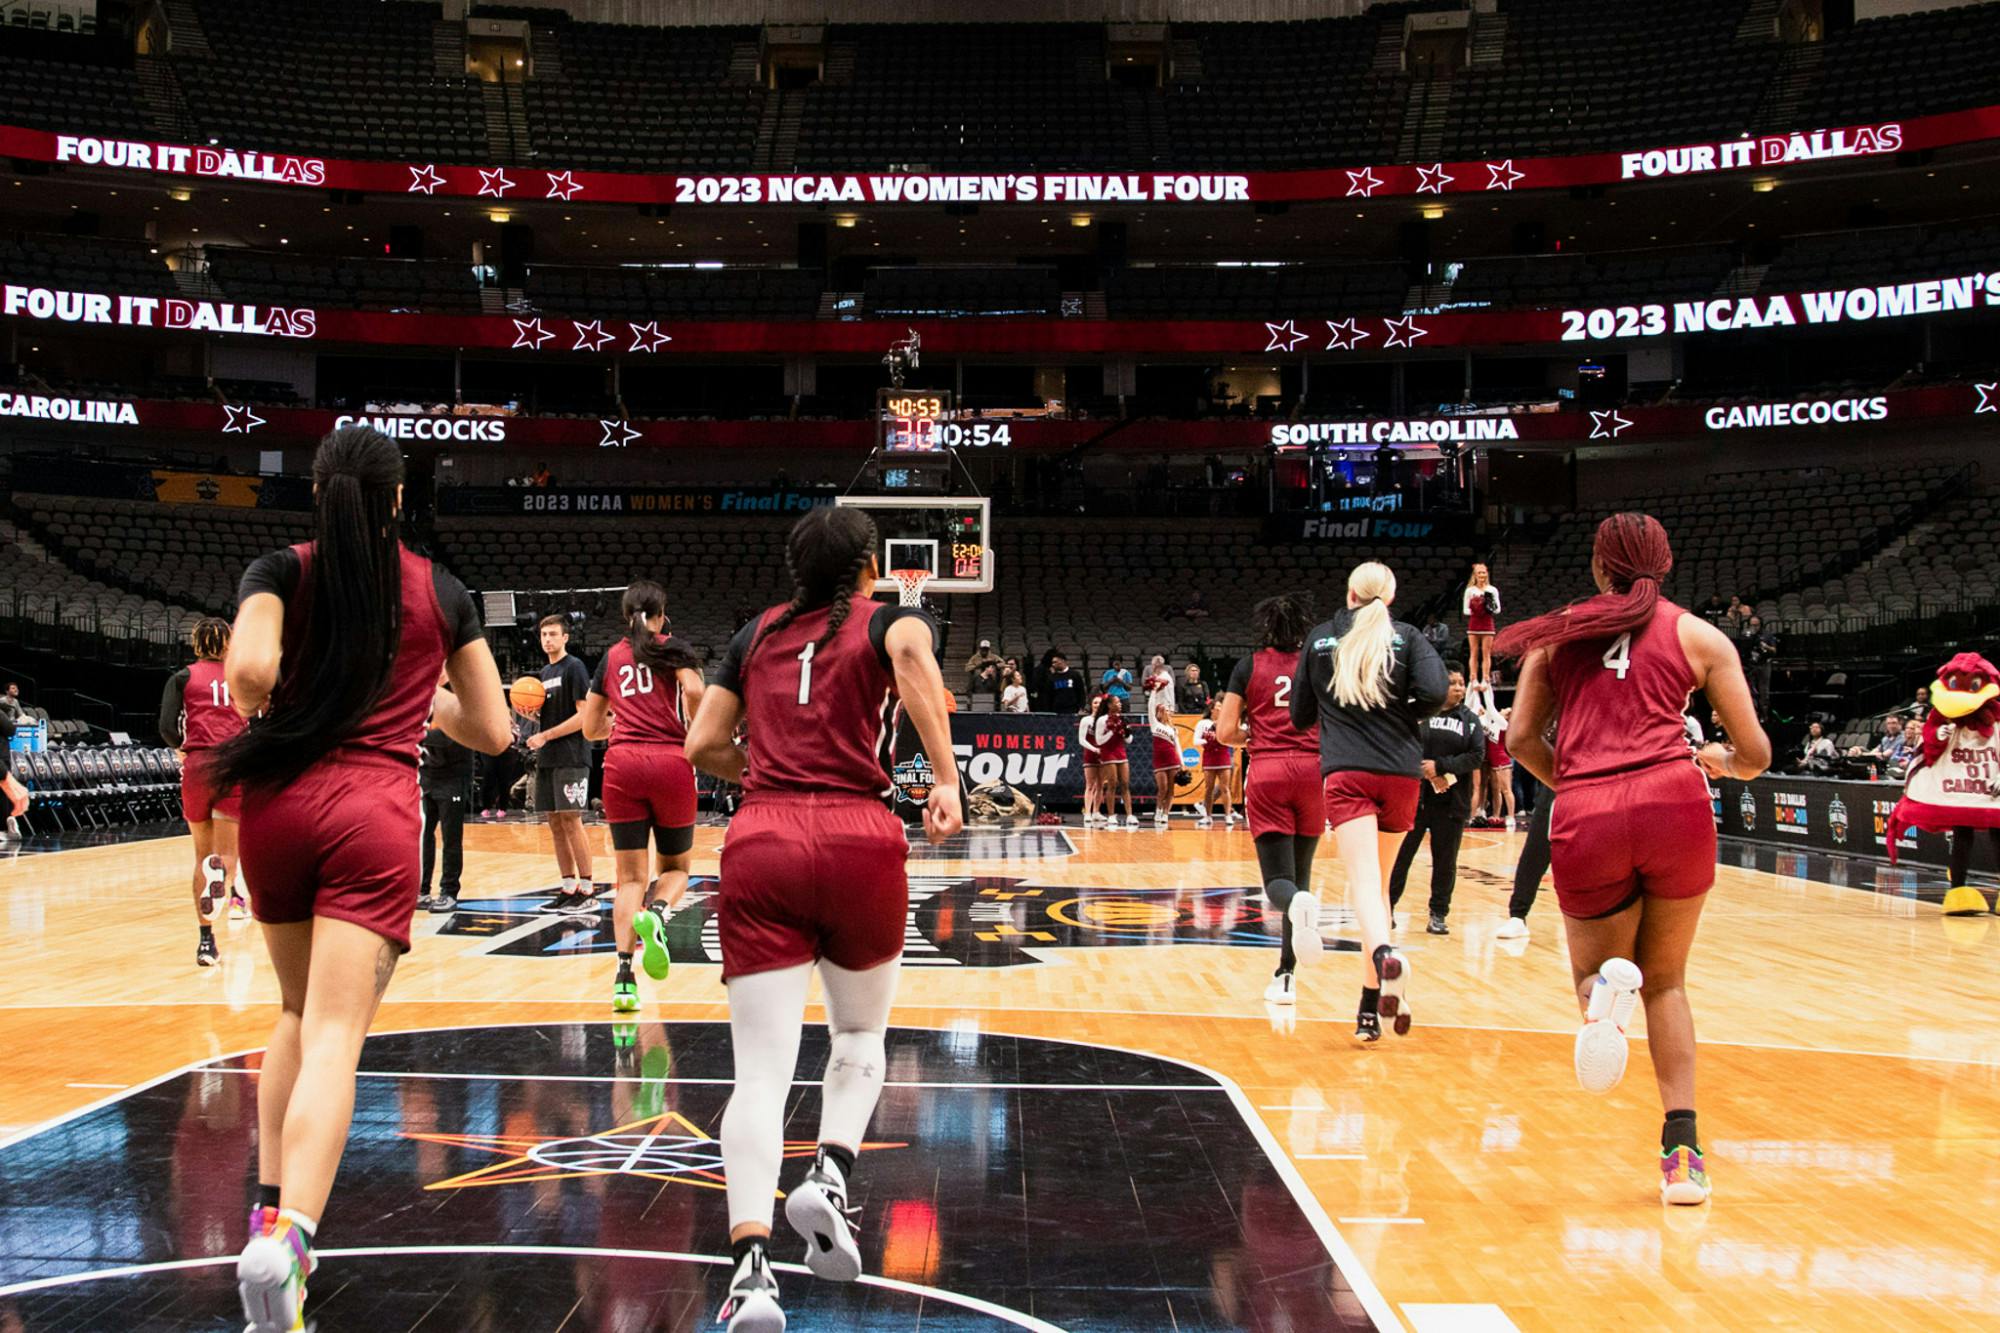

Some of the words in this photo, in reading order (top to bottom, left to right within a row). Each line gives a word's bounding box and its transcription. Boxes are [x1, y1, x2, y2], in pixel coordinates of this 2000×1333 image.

[57, 136, 152, 170] FOUR
[157, 147, 192, 172] IT
[196, 148, 325, 185] DALLAS
[1622, 146, 1717, 179] FOUR
[1720, 140, 1755, 167] IT
[1761, 124, 1903, 165] DALLAS
[676, 177, 761, 203] 2023
[768, 176, 865, 202] NCAA
[869, 174, 1038, 202] WOMEN'S
[1043, 176, 1148, 201] FINAL
[1153, 175, 1249, 201] FOUR
[4, 285, 113, 323] FOUR
[118, 296, 159, 326] IT
[164, 298, 316, 338] DALLAS
[1562, 304, 1666, 341] 2023
[1673, 296, 1797, 333] NCAA
[1801, 271, 2000, 323] WOMEN'S
[0, 392, 139, 425] CAROLINA
[889, 398, 941, 418] 40:53
[1705, 396, 1888, 430] GAMECOCKS
[1271, 422, 1368, 446] SOUTH
[1371, 418, 1519, 442] CAROLINA
[523, 494, 569, 510] 2023
[577, 494, 623, 511] NCAA
[630, 494, 713, 511] WOMEN'S
[721, 492, 780, 511] Final
[1302, 517, 1369, 538] Final
[1372, 519, 1433, 538] Four
[1602, 631, 1631, 680] 4
[618, 663, 654, 698] 20
[797, 642, 816, 706] 1
[209, 679, 230, 707] 11
[1274, 675, 1291, 708] 2
[975, 733, 1066, 751] WOMEN'S
[1942, 778, 1990, 795] CAROL
